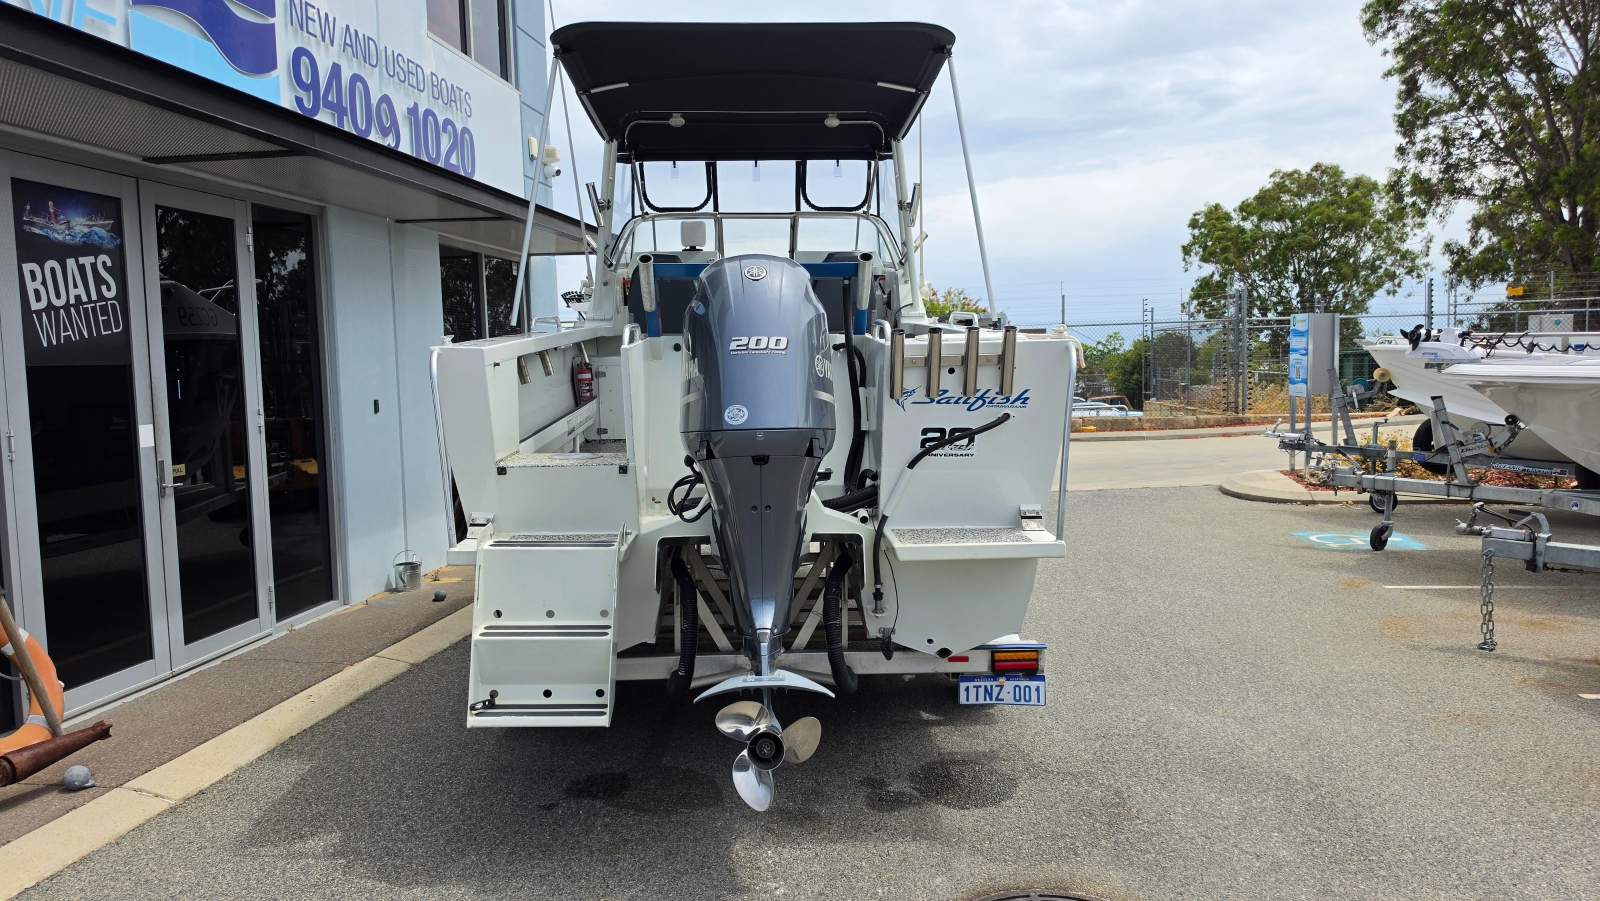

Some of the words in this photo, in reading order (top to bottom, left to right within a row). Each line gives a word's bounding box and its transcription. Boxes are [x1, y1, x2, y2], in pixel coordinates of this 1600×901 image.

[289, 0, 337, 47] NEW
[342, 24, 379, 68] AND
[384, 46, 425, 93] USED
[430, 72, 472, 118] BOATS
[292, 46, 401, 151] 9409
[407, 101, 476, 179] 1020
[22, 254, 117, 311] BOATS
[32, 300, 123, 347] WANTED
[729, 336, 788, 350] 200
